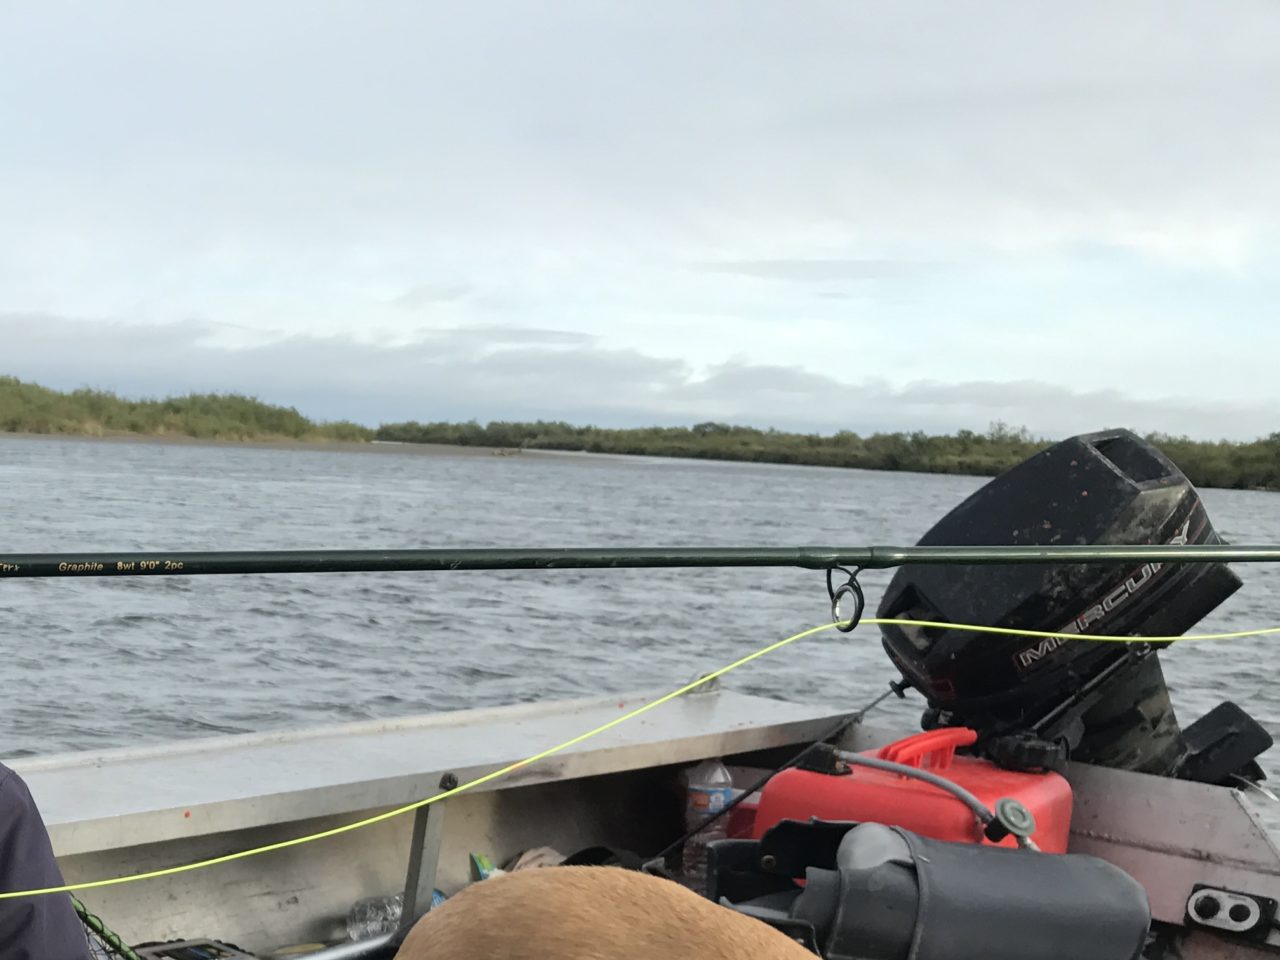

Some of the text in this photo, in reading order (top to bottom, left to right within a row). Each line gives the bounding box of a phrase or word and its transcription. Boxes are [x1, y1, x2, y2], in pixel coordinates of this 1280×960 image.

[58, 561, 104, 573] Graphite
[116, 561, 135, 571] 8wt
[164, 560, 184, 570] 2pc
[1019, 519, 1190, 668] MERCUY
